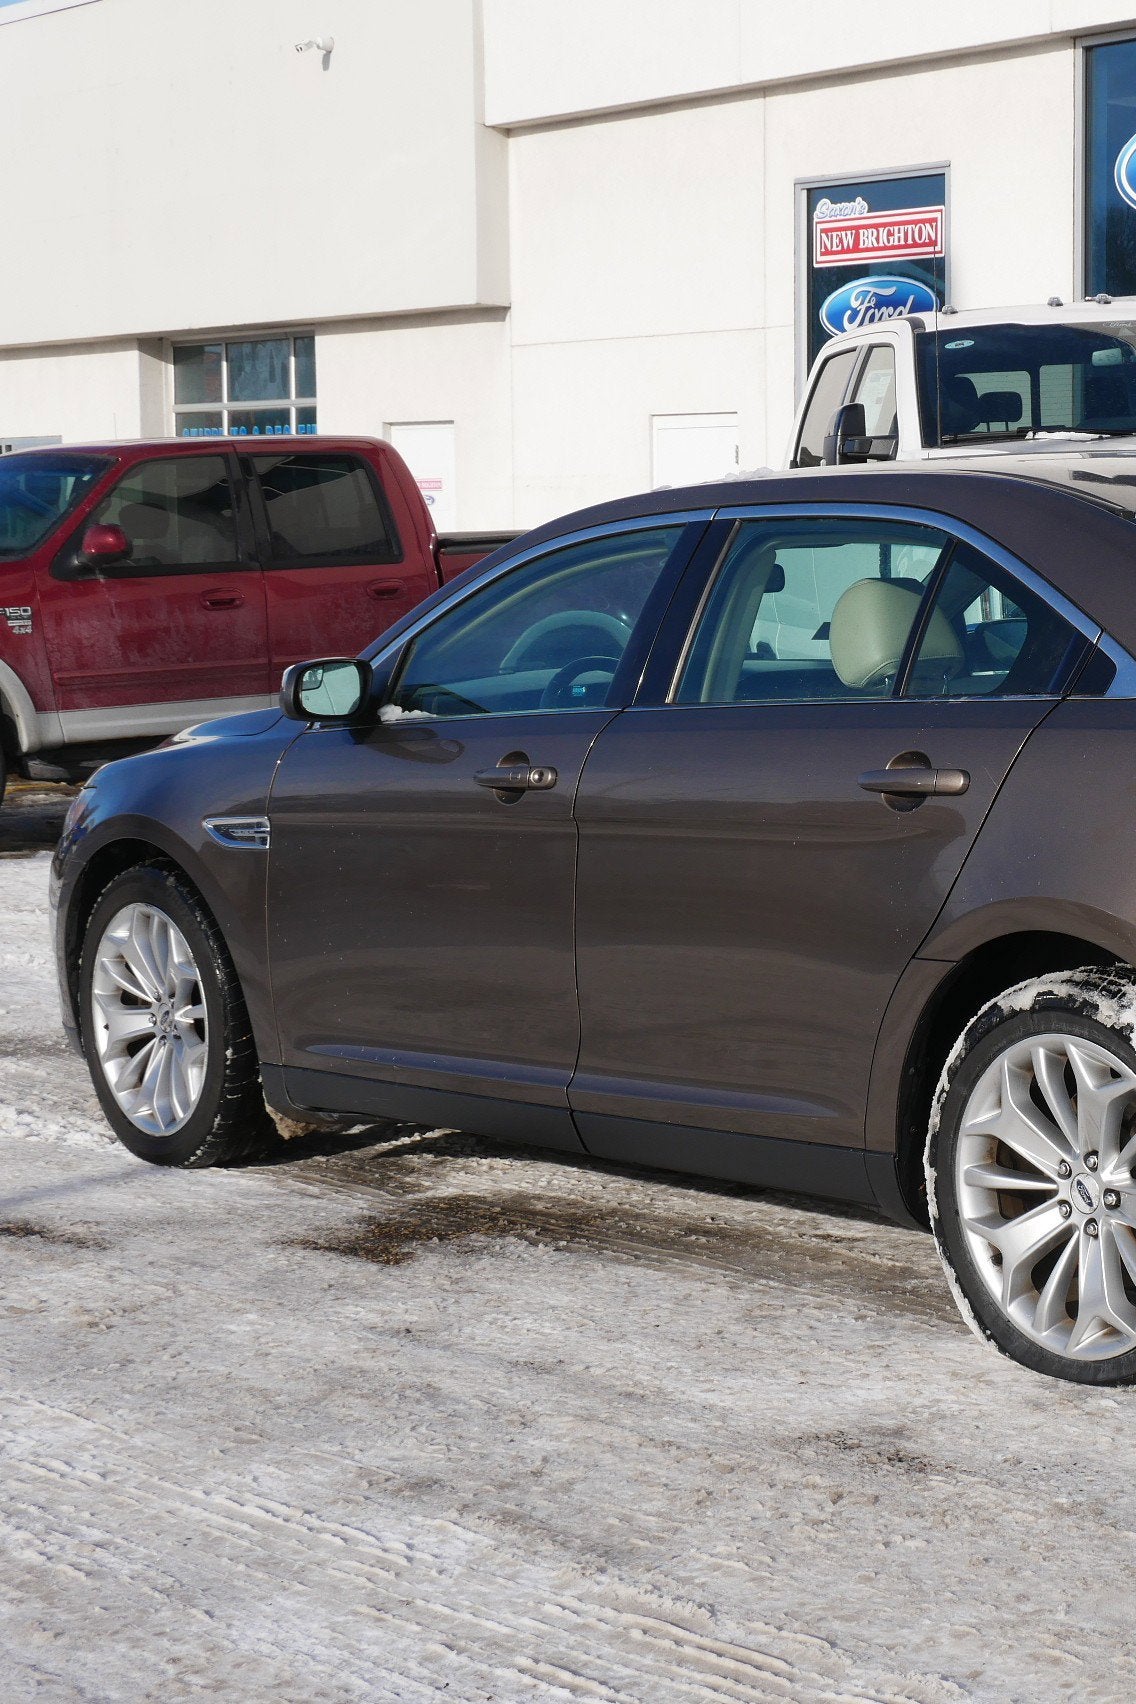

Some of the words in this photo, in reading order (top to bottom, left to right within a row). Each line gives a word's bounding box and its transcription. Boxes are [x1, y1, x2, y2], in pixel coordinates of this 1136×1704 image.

[820, 230, 856, 252] NEW
[858, 222, 937, 249] BRIGHTON
[843, 286, 914, 331] Ford
